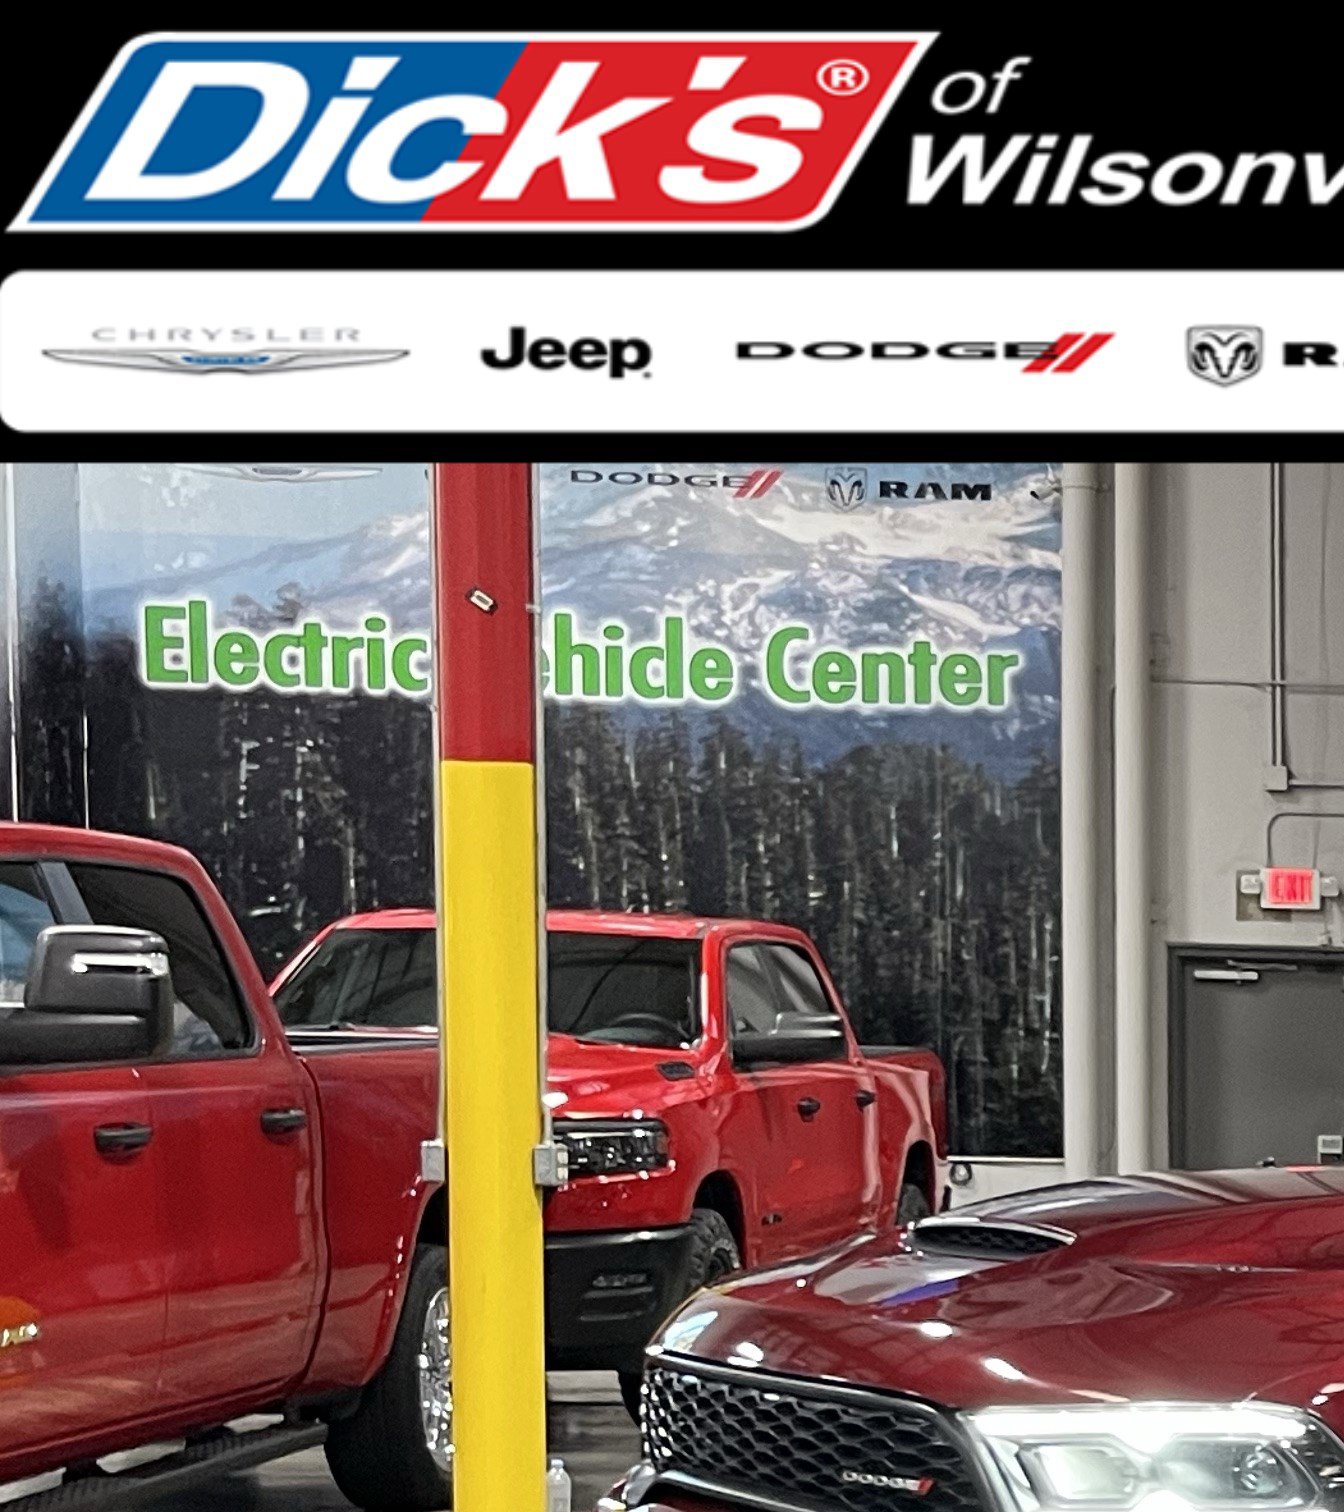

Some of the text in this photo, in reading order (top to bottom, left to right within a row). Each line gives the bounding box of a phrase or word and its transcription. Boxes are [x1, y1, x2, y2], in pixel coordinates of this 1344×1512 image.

[569, 469, 752, 489] DODGE
[878, 479, 992, 501] RAM
[143, 600, 1018, 707] Electric hicle Center
[1273, 873, 1313, 902] EXIT
[842, 1470, 920, 1491] DODGE
